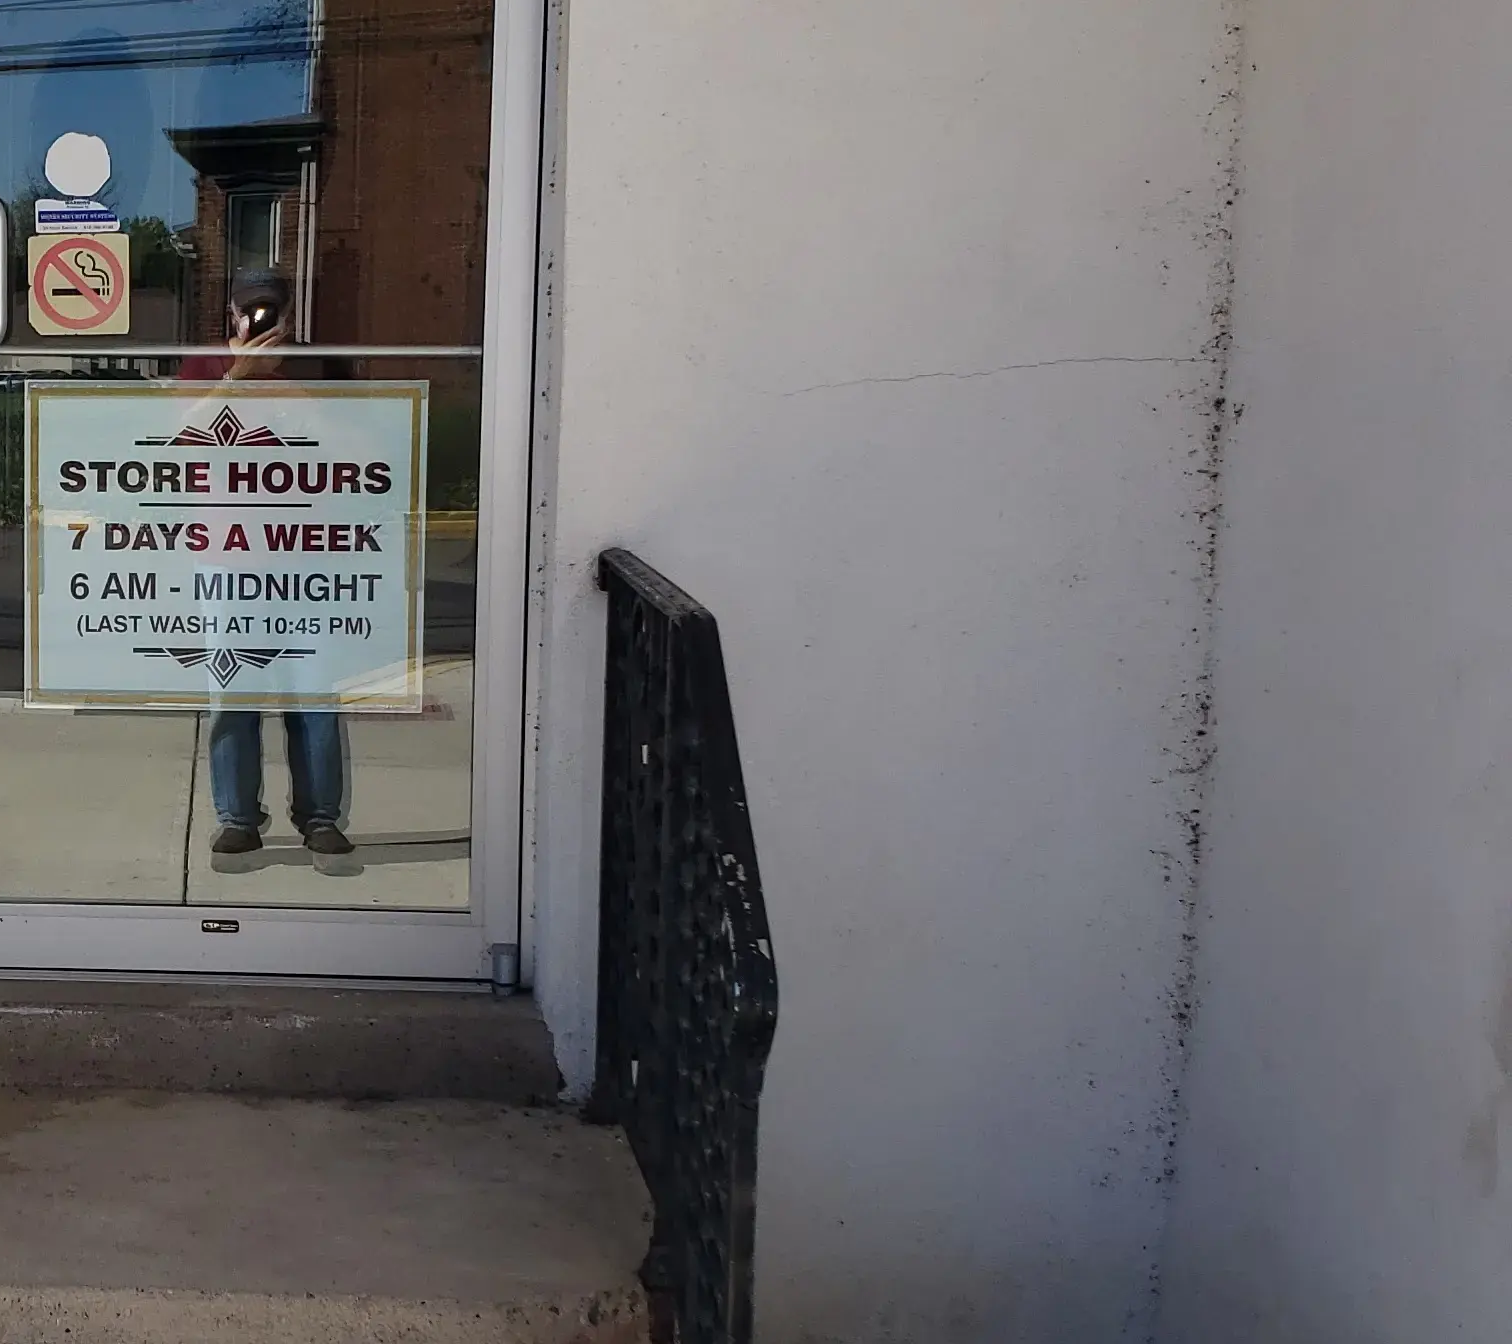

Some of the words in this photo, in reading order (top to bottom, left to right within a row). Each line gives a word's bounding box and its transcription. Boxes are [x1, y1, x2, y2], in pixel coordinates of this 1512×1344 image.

[59, 461, 211, 493] STORE
[227, 461, 392, 494] HOURS
[68, 523, 88, 551] 7
[104, 523, 209, 551] DAYS
[223, 524, 250, 551] A
[264, 524, 382, 552] WEEK
[70, 573, 90, 600] 6
[101, 573, 157, 600] AM
[193, 573, 383, 602] MIDNIGHT
[76, 615, 143, 637] (LAST
[148, 615, 217, 635] WASH
[225, 616, 254, 635] AT
[262, 617, 320, 636] 10:45
[329, 617, 372, 640] PM)
